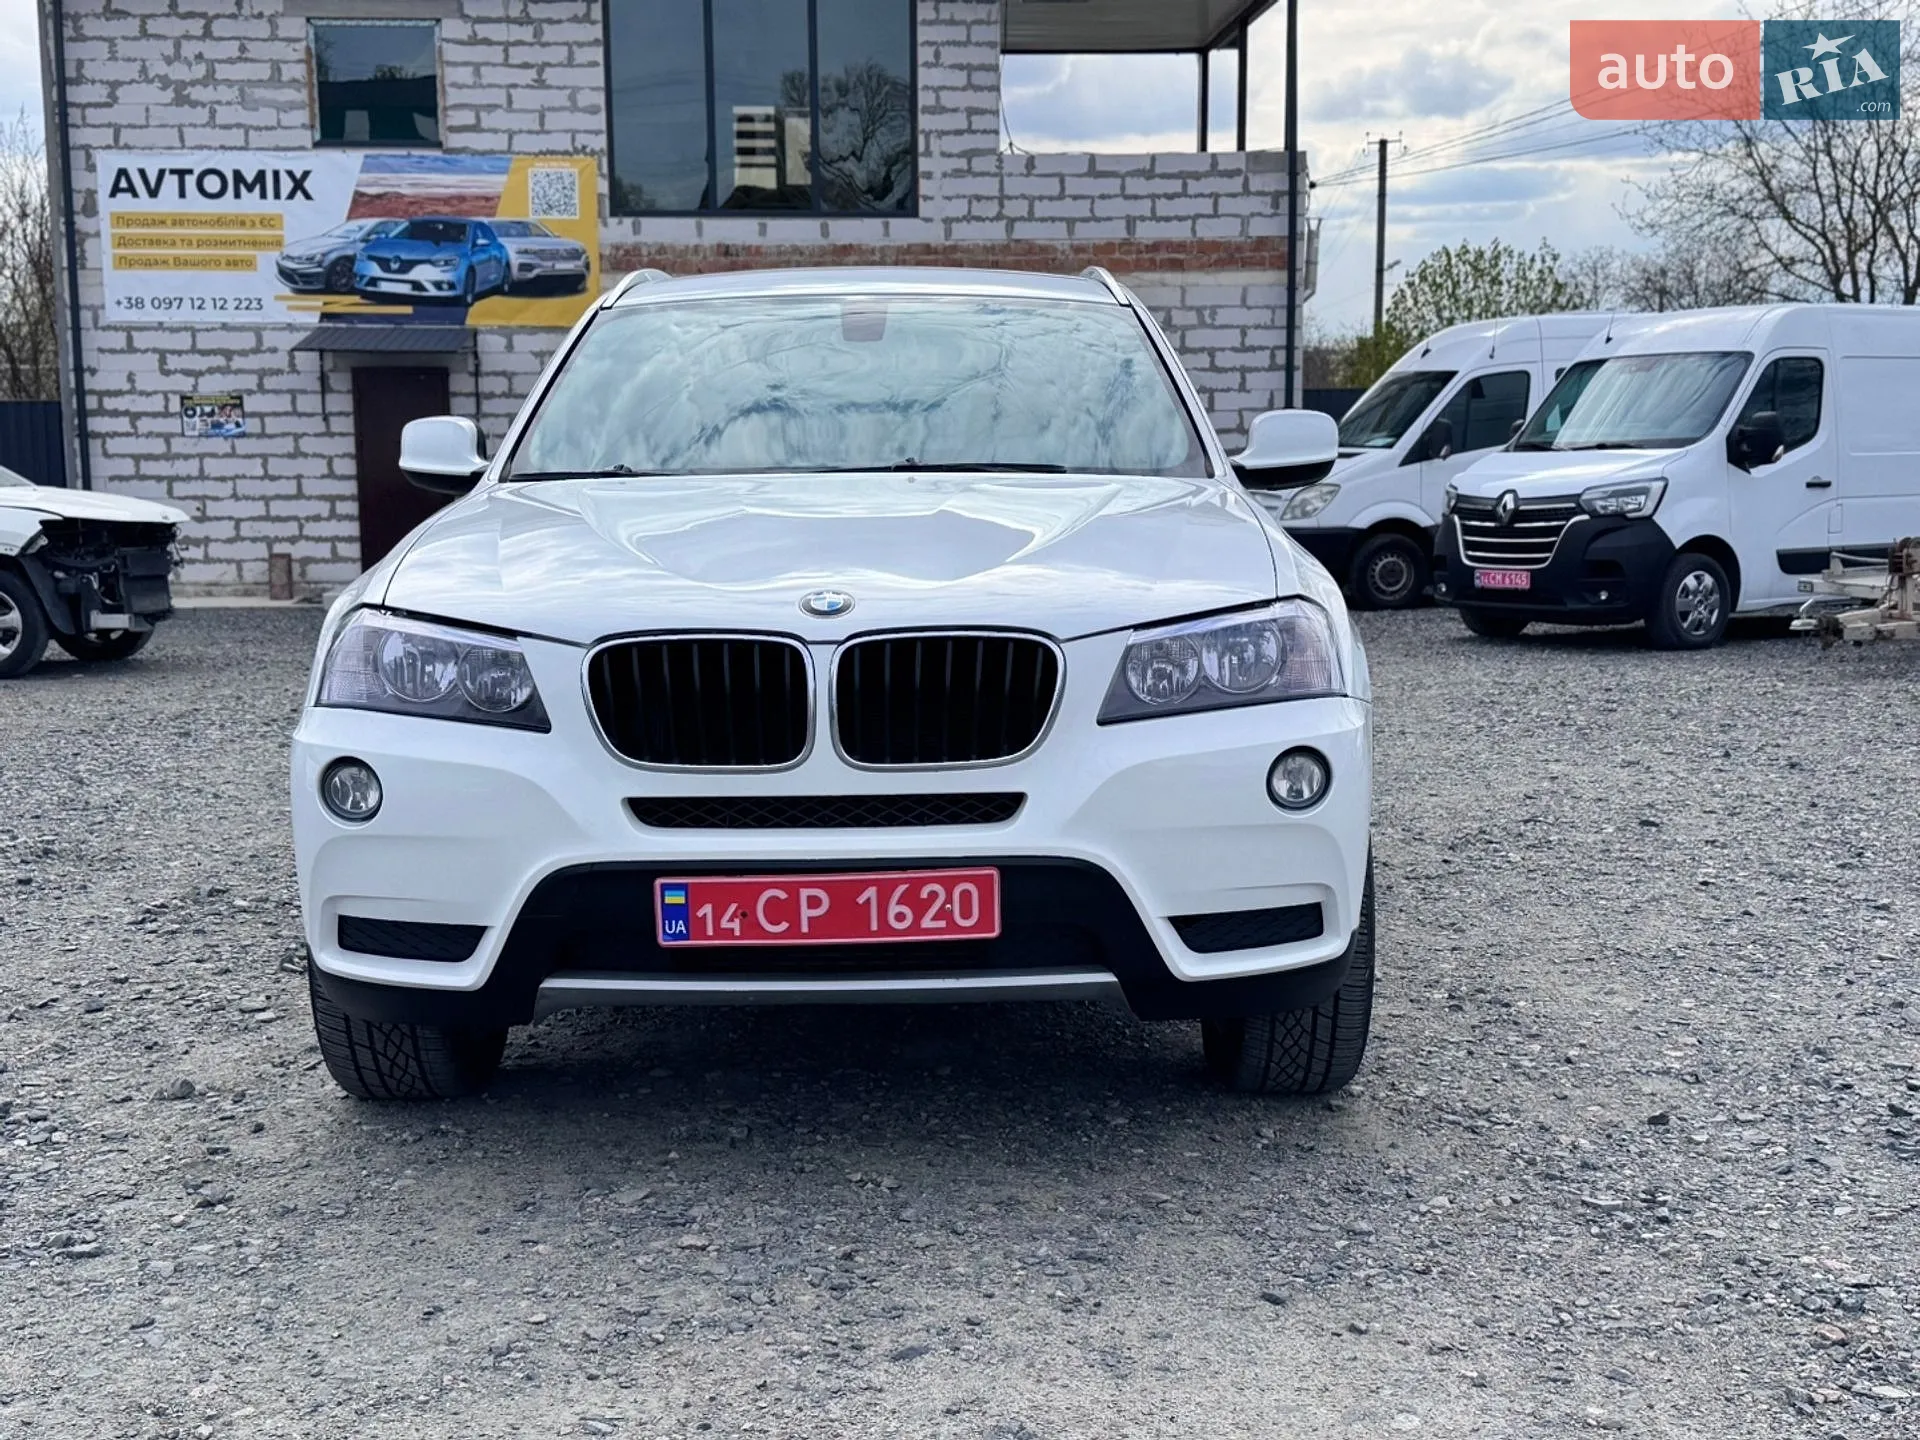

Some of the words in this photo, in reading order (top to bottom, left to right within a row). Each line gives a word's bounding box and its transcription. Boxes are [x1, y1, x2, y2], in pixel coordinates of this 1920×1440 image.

[108, 167, 314, 201] AVTOMIX
[116, 215, 167, 230] Продаж
[171, 215, 246, 228] автомобілів
[248, 218, 257, 228] з
[259, 216, 275, 228] ЄС
[117, 236, 176, 248] Доставка
[180, 237, 193, 248] та
[197, 236, 282, 249] розмитнення
[118, 256, 169, 267] Продаж
[173, 256, 221, 267] Вашого
[225, 257, 252, 267] авто
[115, 297, 145, 310] +38
[150, 297, 183, 310] 097
[189, 297, 206, 310] 12
[210, 297, 228, 311] 12
[233, 297, 263, 311] 223
[696, 902, 742, 936] 14
[756, 888, 830, 933] CP
[856, 882, 979, 932] 1620
[665, 920, 687, 934] UA
